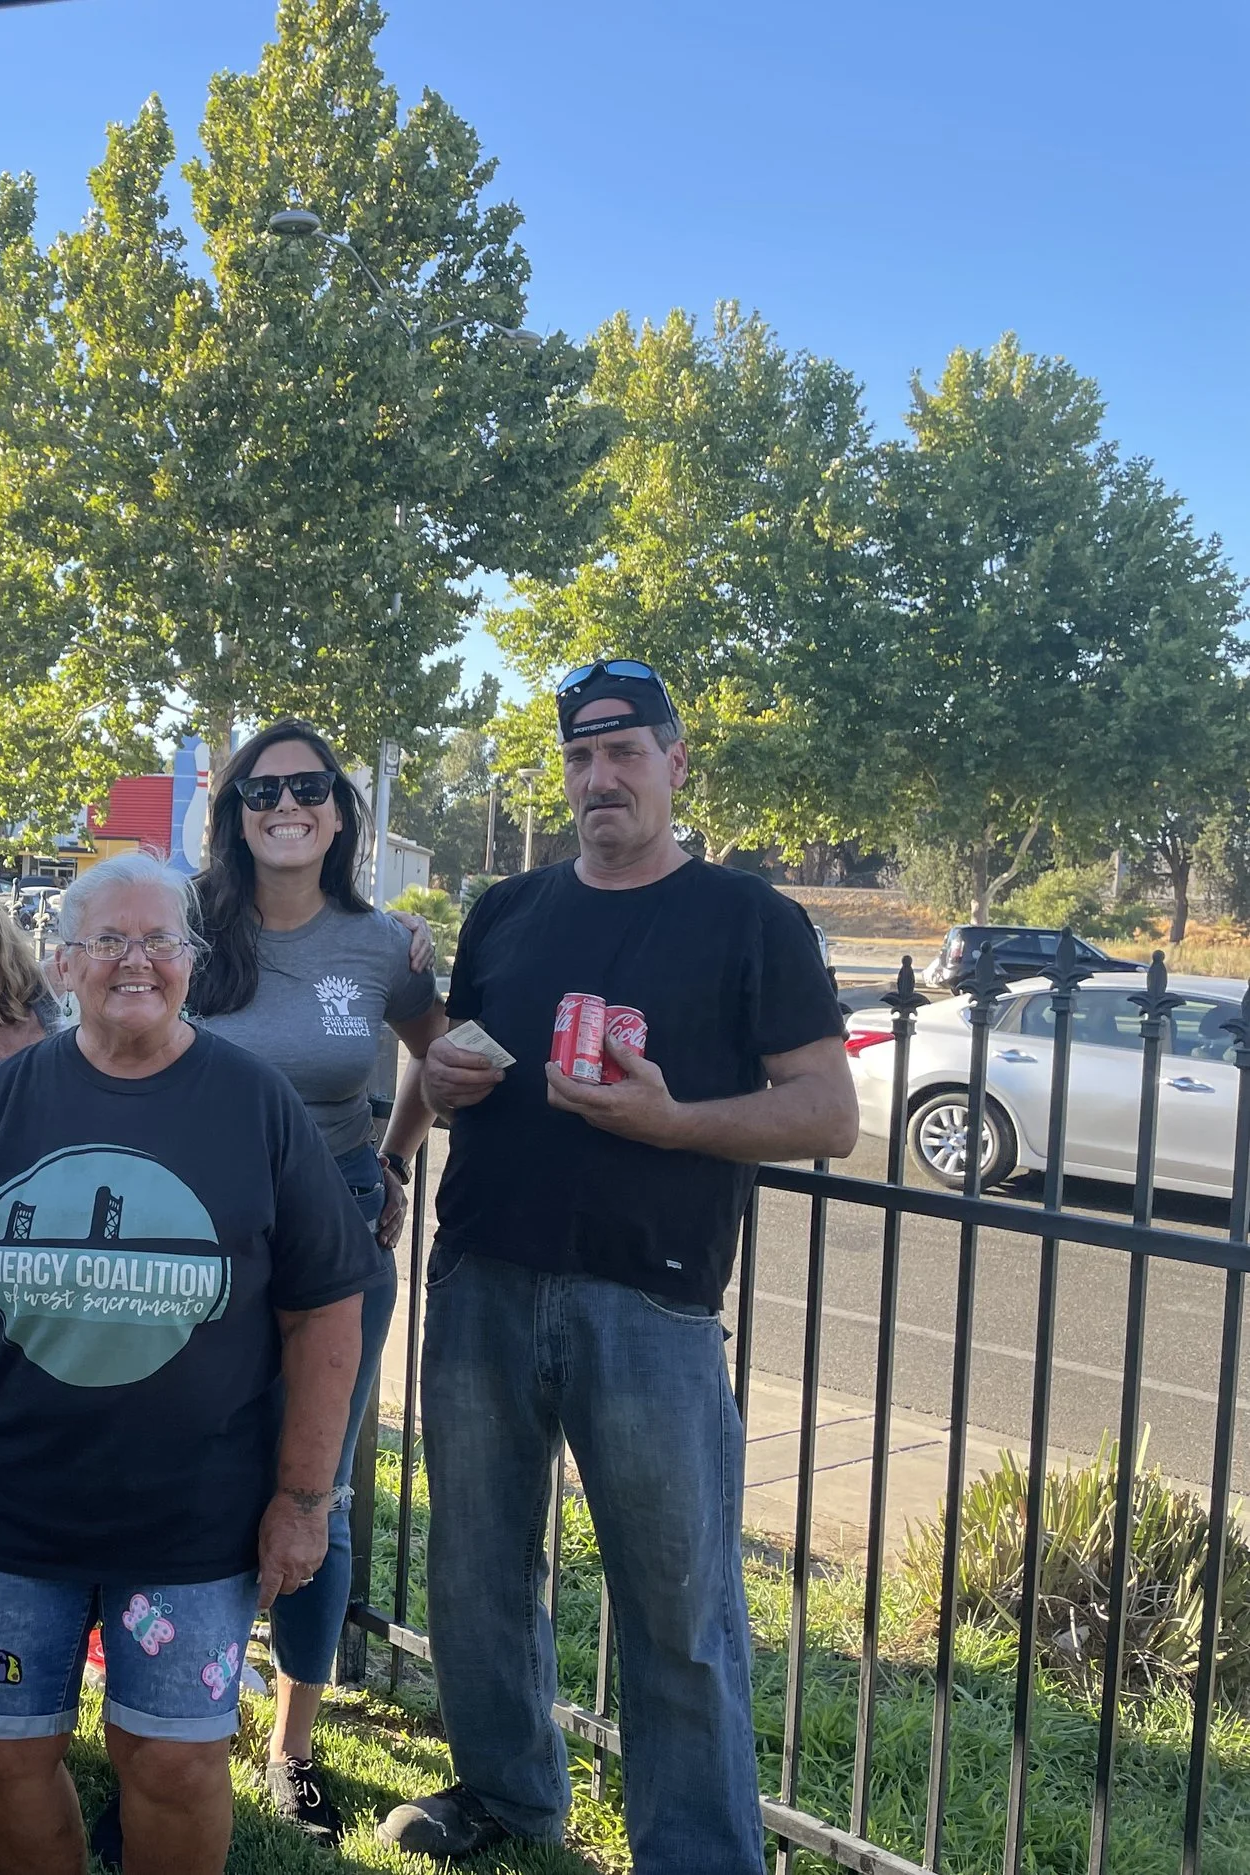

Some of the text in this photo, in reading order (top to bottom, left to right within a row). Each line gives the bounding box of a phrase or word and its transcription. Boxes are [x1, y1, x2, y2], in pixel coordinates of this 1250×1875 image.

[325, 1027, 371, 1037] ALLIANCE
[75, 1255, 216, 1298] COALITION
[3, 1283, 204, 1318] of west sacramento
